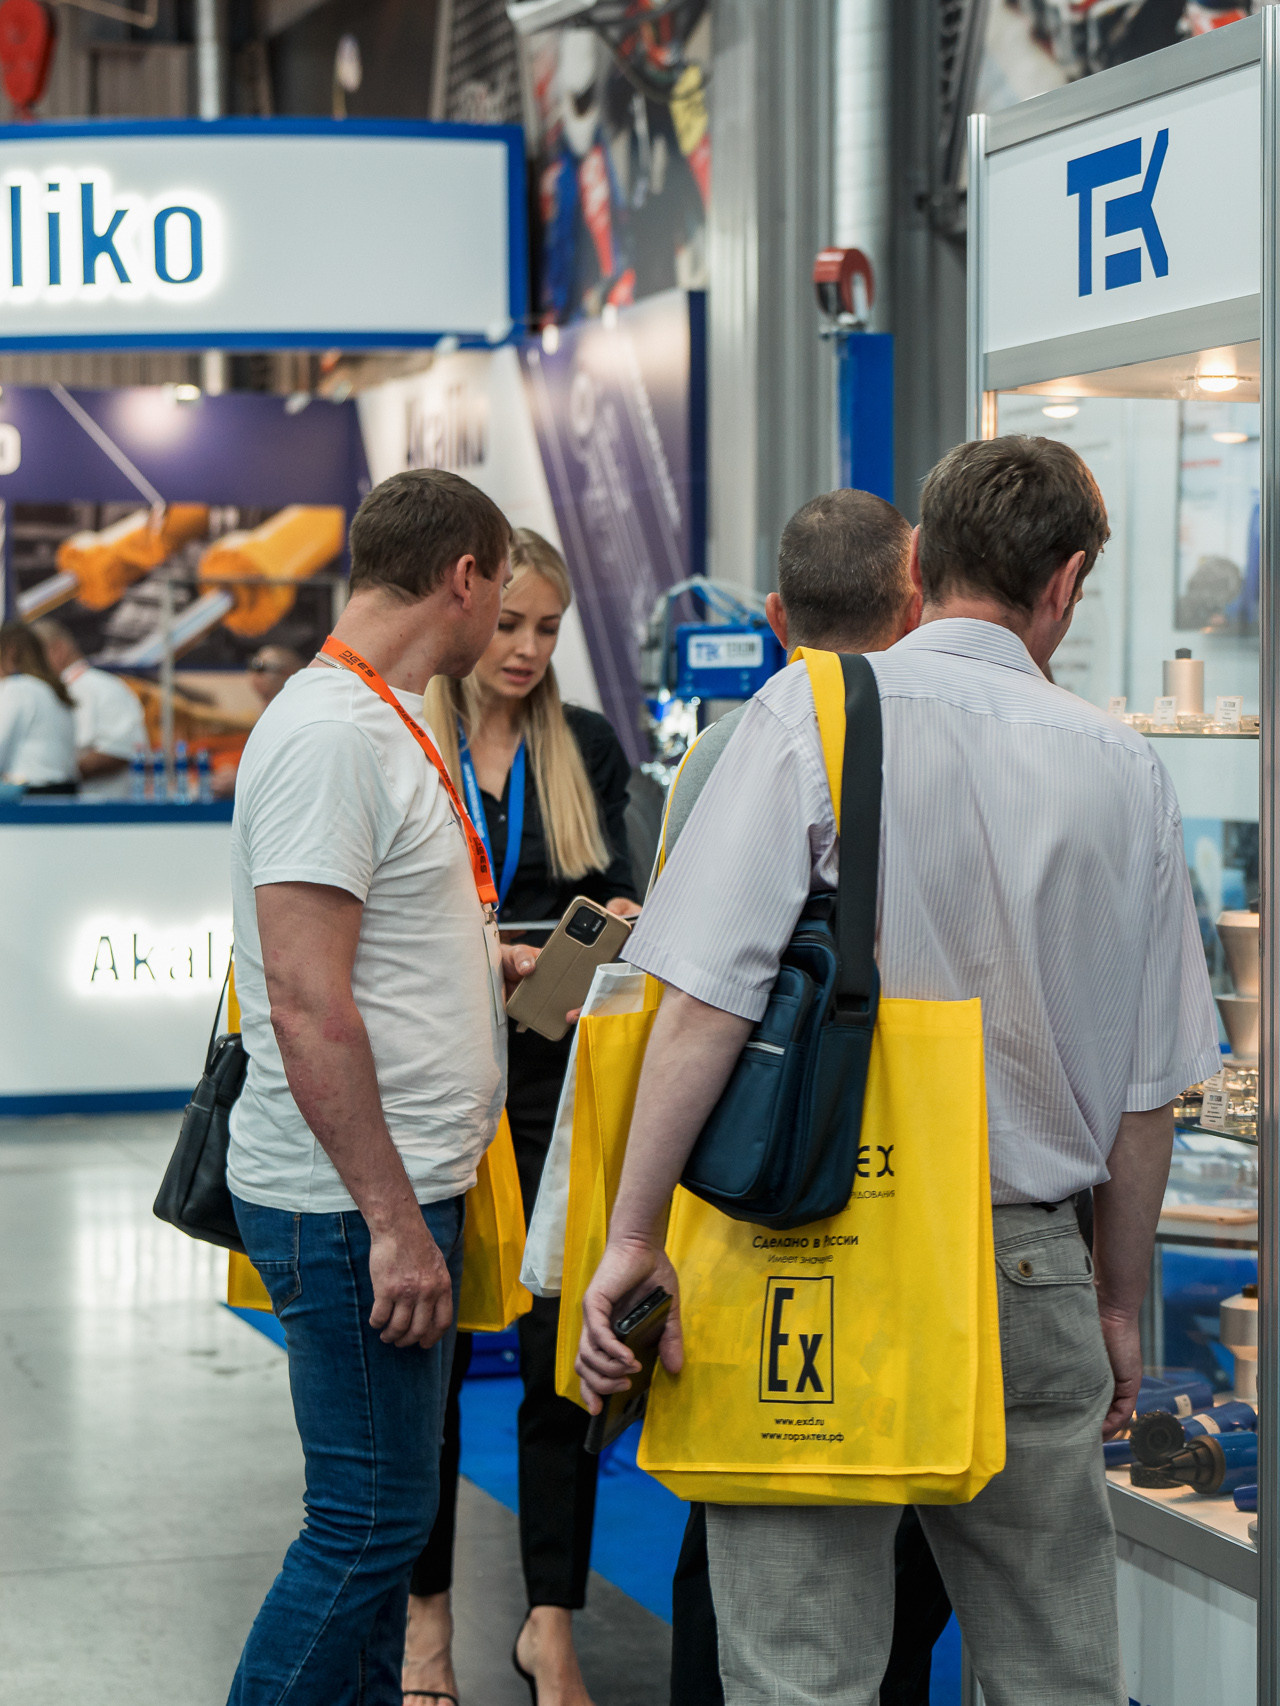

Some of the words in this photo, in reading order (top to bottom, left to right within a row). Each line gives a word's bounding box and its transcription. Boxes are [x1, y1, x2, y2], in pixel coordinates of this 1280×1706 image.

[10, 183, 203, 286] liko
[1067, 128, 1169, 297] TEK
[752, 1235, 809, 1249] Сделано
[768, 1287, 824, 1392] Ex
